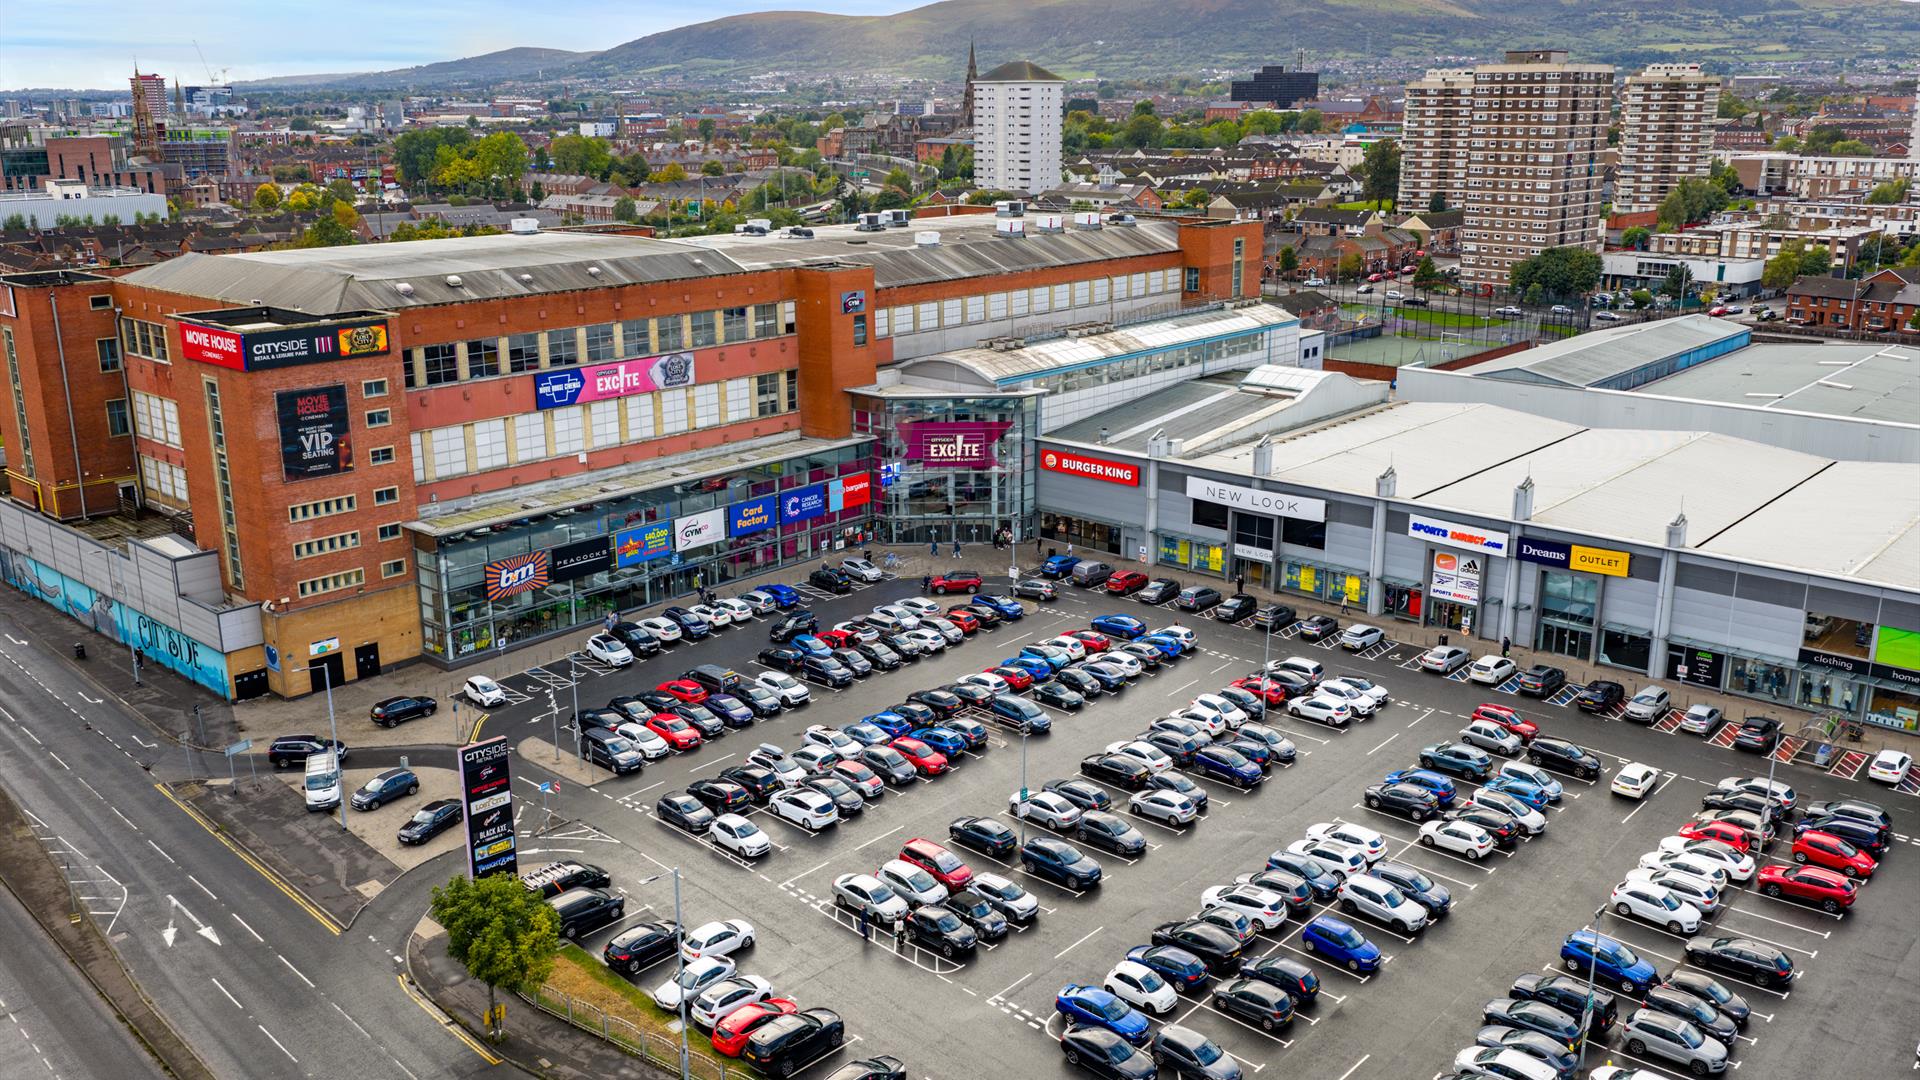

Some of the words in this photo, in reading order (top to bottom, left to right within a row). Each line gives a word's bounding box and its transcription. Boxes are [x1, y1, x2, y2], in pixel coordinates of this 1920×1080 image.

[186, 329, 209, 347] MOVIE
[210, 335, 237, 353] HOUSE
[253, 339, 308, 355] CITYSIDE
[539, 386, 551, 394] MOVIE
[552, 384, 564, 392] HOUSE
[564, 381, 581, 390] CINEMAS
[297, 394, 329, 406] MOVIE
[297, 403, 330, 415] HOUSE
[301, 432, 333, 451] VIP
[302, 448, 335, 460] SEATING
[1062, 459, 1104, 475] BURGER
[1105, 466, 1132, 480] KING
[845, 481, 869, 493] bargains
[801, 494, 818, 503] CANCER
[801, 499, 823, 508] RESEARCH
[1206, 486, 1242, 502] NEW
[1251, 495, 1298, 512] LOOK
[742, 504, 763, 517] Card
[737, 514, 769, 529] Factory
[1412, 522, 1448, 538] SPORTS
[557, 549, 608, 567] PEACOCKS
[1236, 547, 1252, 555] NEW
[1522, 543, 1566, 562] Dreams
[1579, 554, 1620, 568] OUTLET
[1433, 588, 1452, 596] SPORTS
[138, 616, 202, 670] CITYSIDE
[1814, 654, 1853, 671] clothing
[1892, 670, 1920, 684] home
[464, 742, 507, 762] CITYSIDE
[476, 756, 494, 764] RETAIL
[475, 801, 490, 811] LOST
[490, 796, 506, 806] CITY
[480, 827, 497, 839] BLACK
[496, 823, 508, 833] AXE
